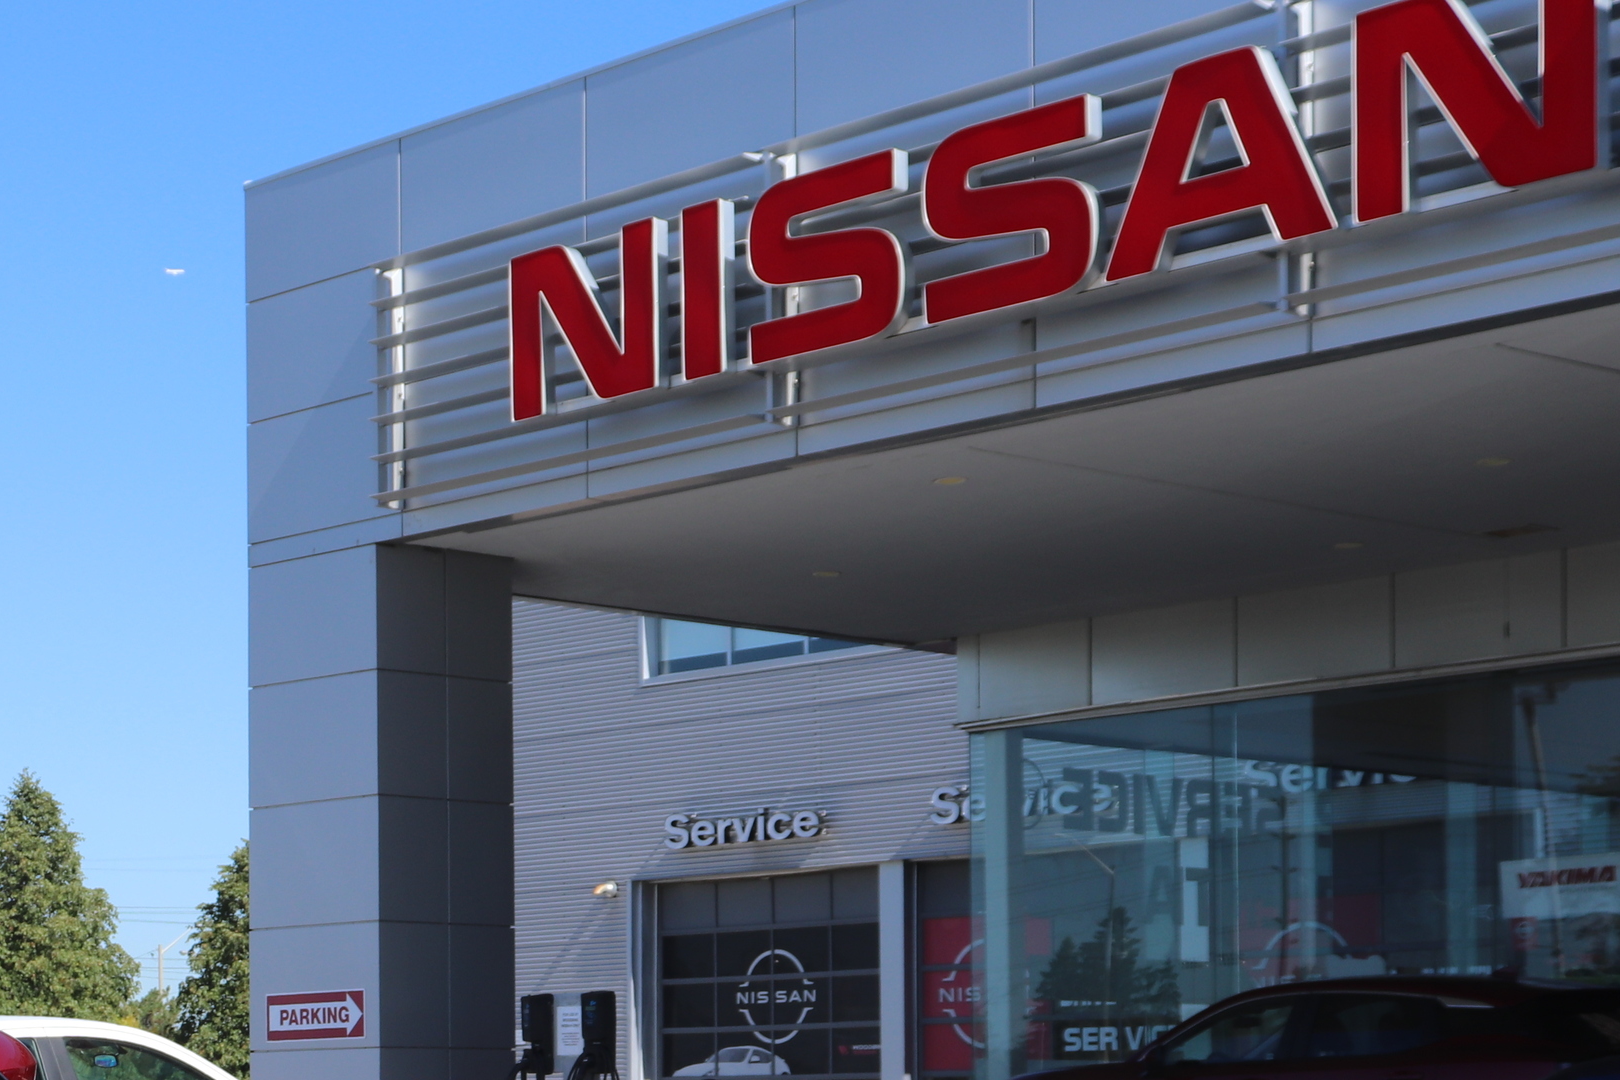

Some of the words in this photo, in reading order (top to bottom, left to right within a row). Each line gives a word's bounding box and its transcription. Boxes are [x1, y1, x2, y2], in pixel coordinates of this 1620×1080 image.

[508, 0, 1602, 423] NISSAN
[664, 807, 820, 850] Service
[736, 989, 817, 1004] NISSAN
[280, 1006, 350, 1026] PARKING
